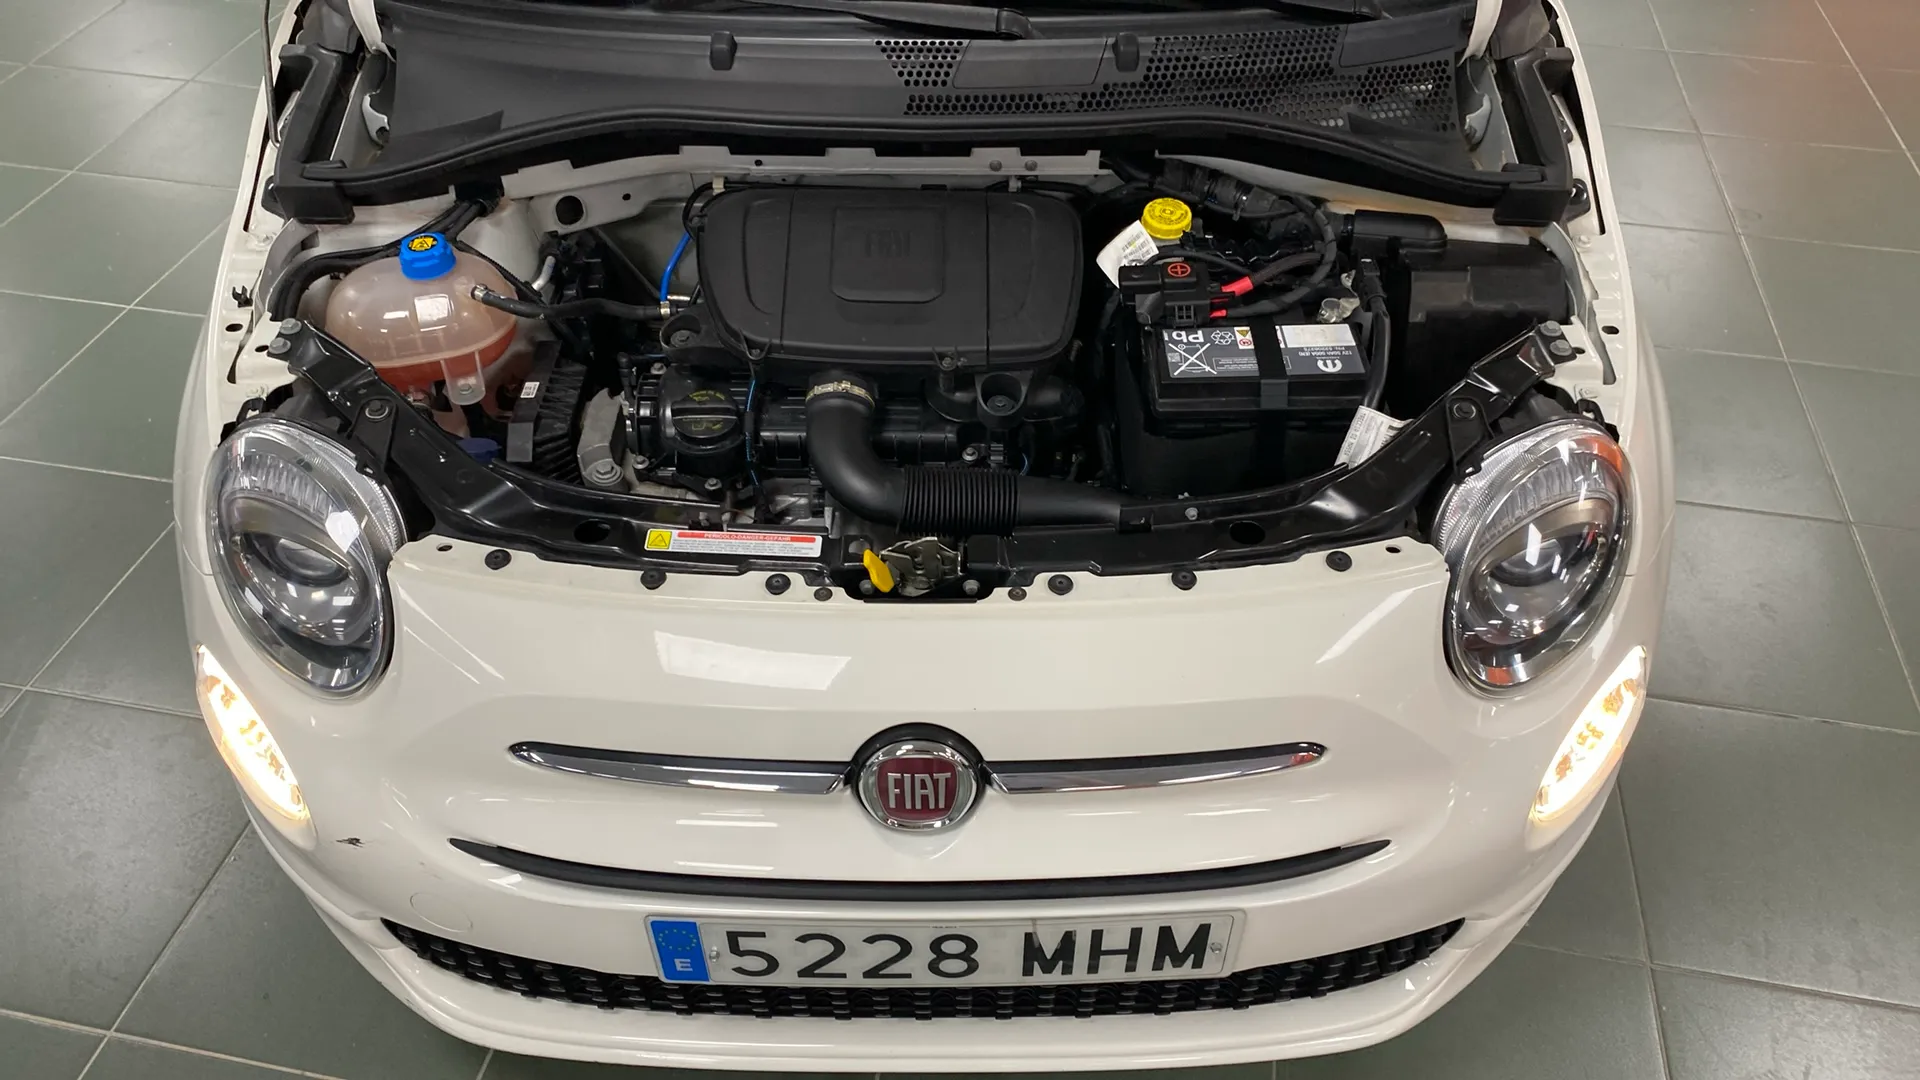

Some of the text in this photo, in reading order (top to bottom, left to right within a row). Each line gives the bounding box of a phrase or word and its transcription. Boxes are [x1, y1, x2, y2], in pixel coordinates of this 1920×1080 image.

[1172, 330, 1204, 343] Pb
[887, 773, 951, 809] FIAT
[725, 922, 1213, 979] 5228 MHM
[675, 958, 695, 973] E
